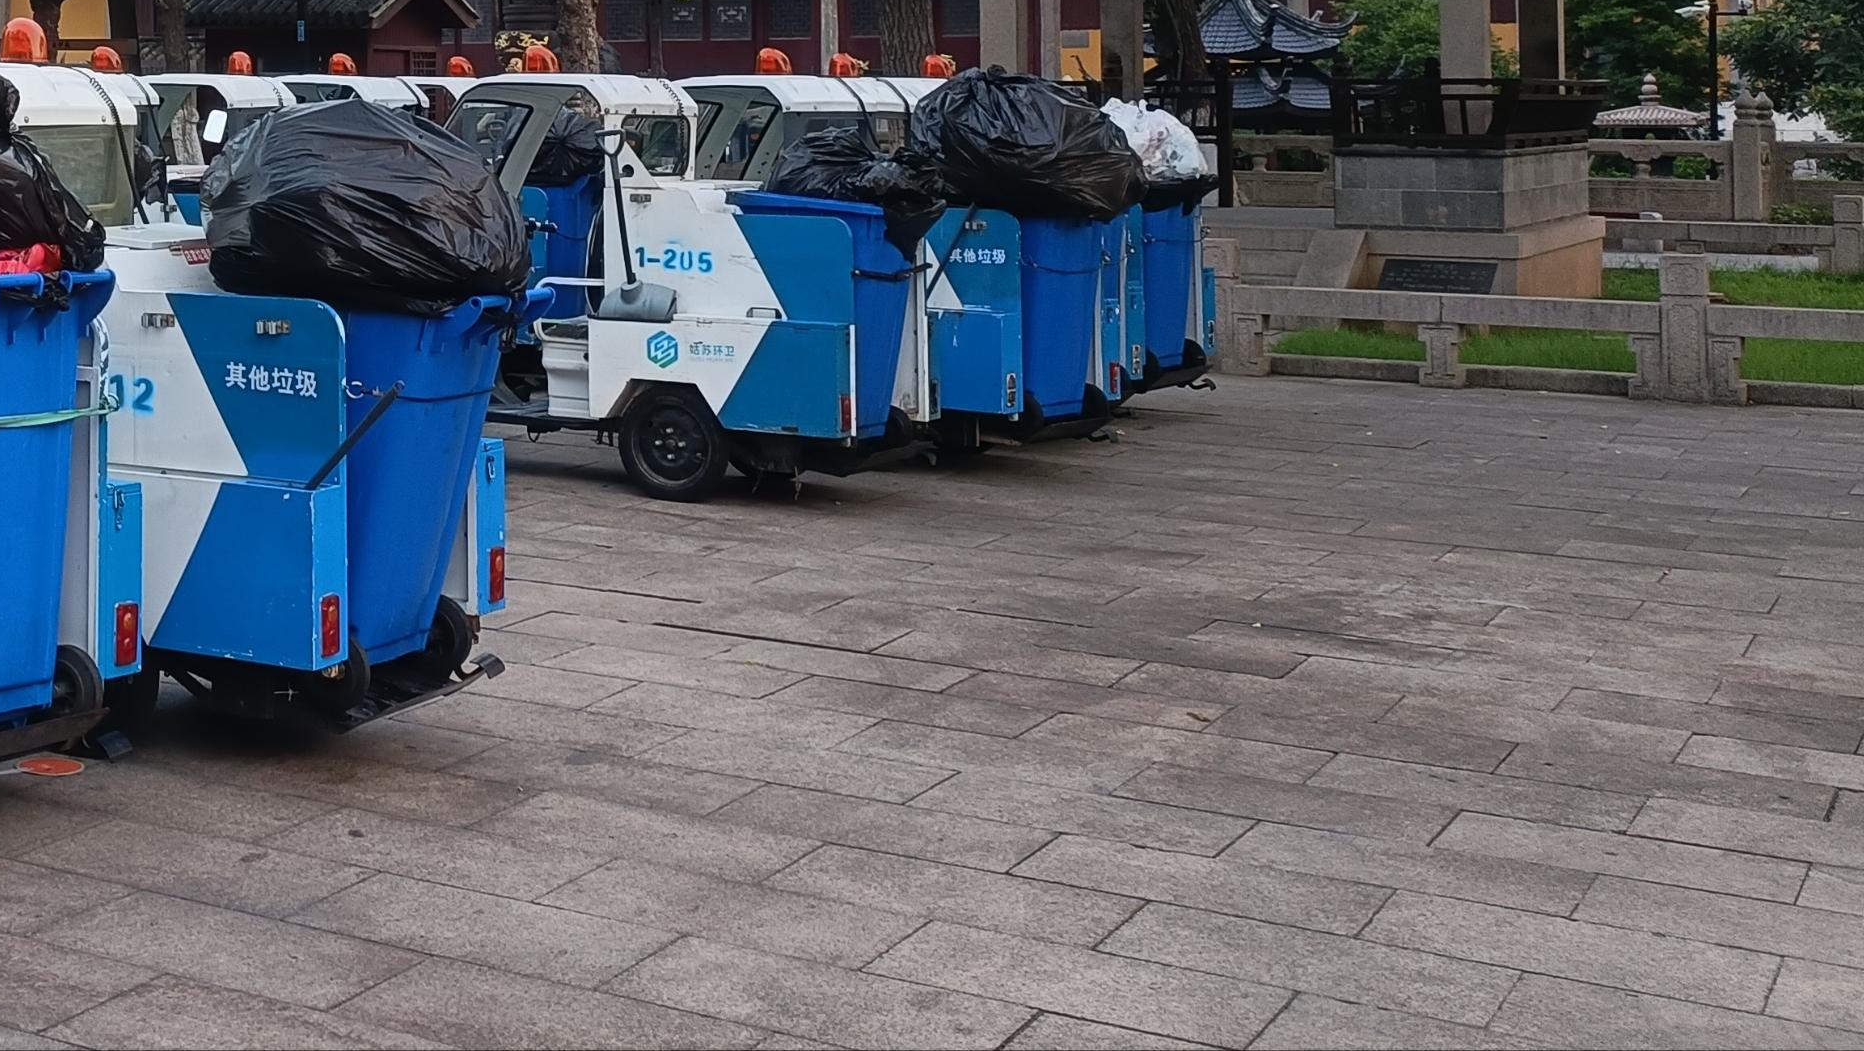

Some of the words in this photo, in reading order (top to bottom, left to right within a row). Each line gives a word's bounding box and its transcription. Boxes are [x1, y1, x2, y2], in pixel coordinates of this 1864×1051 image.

[635, 246, 713, 273] 1-205
[949, 248, 1006, 264] 其他垃圾
[224, 361, 319, 399] 其他垃圾
